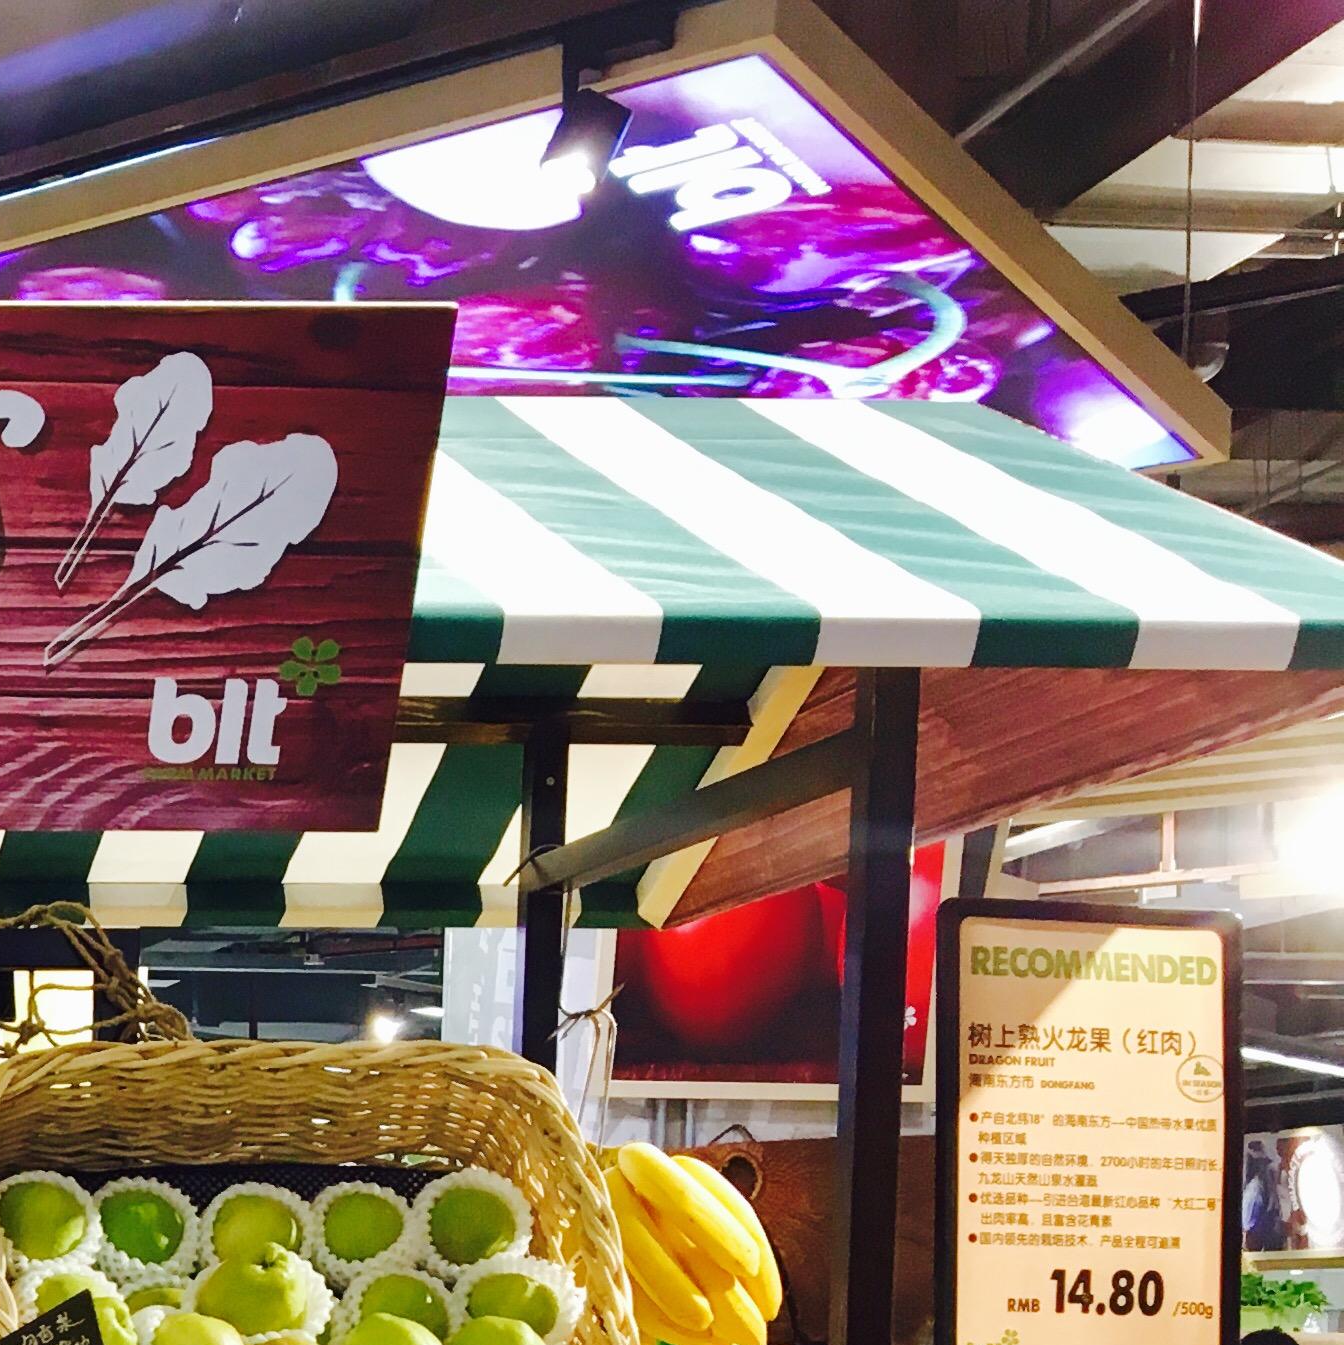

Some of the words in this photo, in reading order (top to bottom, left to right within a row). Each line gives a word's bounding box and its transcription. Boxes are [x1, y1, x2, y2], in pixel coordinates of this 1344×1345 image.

[148, 677, 288, 764] blt
[970, 945, 1218, 985] RECOMMENDED
[1024, 1056, 1055, 1067] FRUIT
[1007, 1299, 1040, 1312] RMB
[1050, 1269, 1164, 1316] 14.80
[1173, 1302, 1213, 1319] /500g
